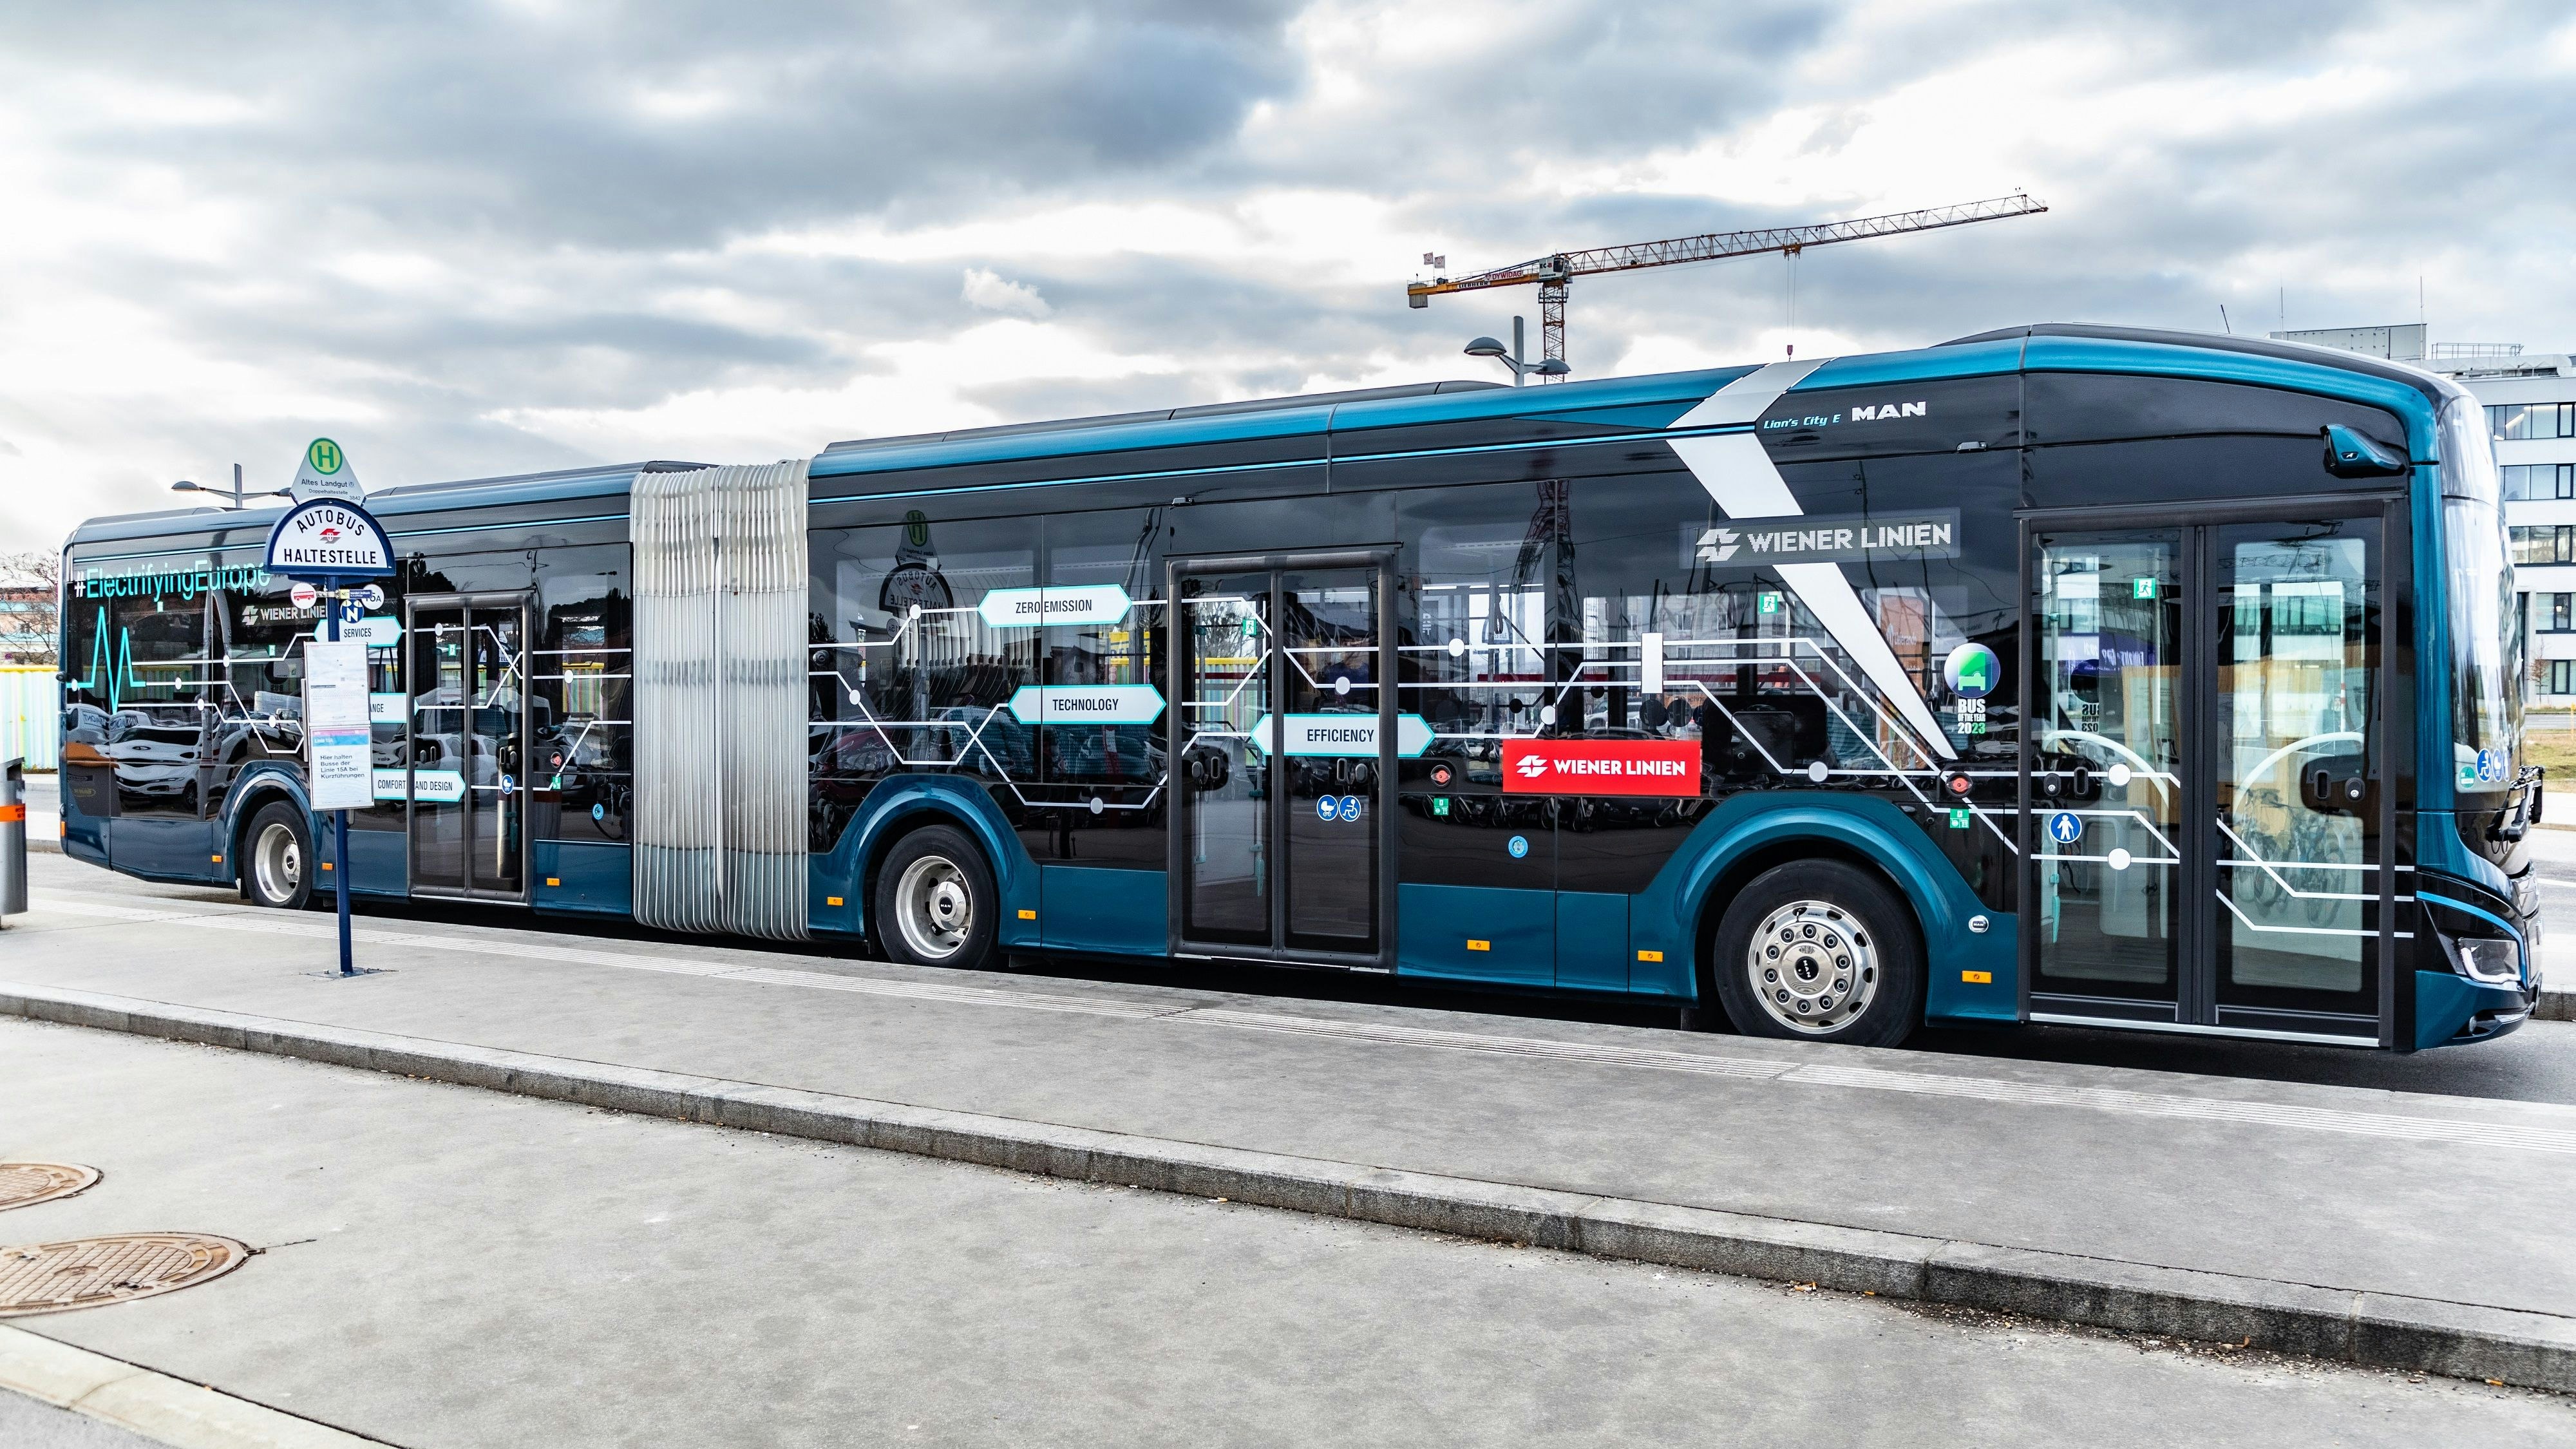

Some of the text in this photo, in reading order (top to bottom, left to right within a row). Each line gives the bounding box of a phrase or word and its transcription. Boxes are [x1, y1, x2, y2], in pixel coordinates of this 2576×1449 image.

[1492, 270, 1522, 280] DYWIDAG
[1852, 401, 1926, 422] MAN
[1764, 413, 1841, 429] Lion's City E
[317, 445, 334, 468] H
[321, 480, 348, 488] Landgut
[297, 509, 364, 536] AUTOBUS
[1747, 524, 1951, 553] WIENER LINIEN
[284, 549, 376, 564] HALTESTELLE
[75, 560, 270, 602] #ElectrifyingEurope
[260, 605, 328, 620] WIENER LINIE
[346, 607, 358, 621] N
[1016, 599, 1092, 614] ZERO EMISSION
[344, 628, 371, 638] SERVICES
[370, 703, 384, 713] NGE
[1052, 698, 1119, 712] TECHNOLOGY
[1958, 699, 1985, 714] BUS
[1958, 714, 1985, 722] OF THE YEAR
[1307, 728, 1374, 743] EFFICIENCY
[1958, 722, 1985, 734] 2023
[1553, 759, 1685, 776] WIENER LINIEN
[378, 780, 453, 791] COMFORT AND DESIGN
